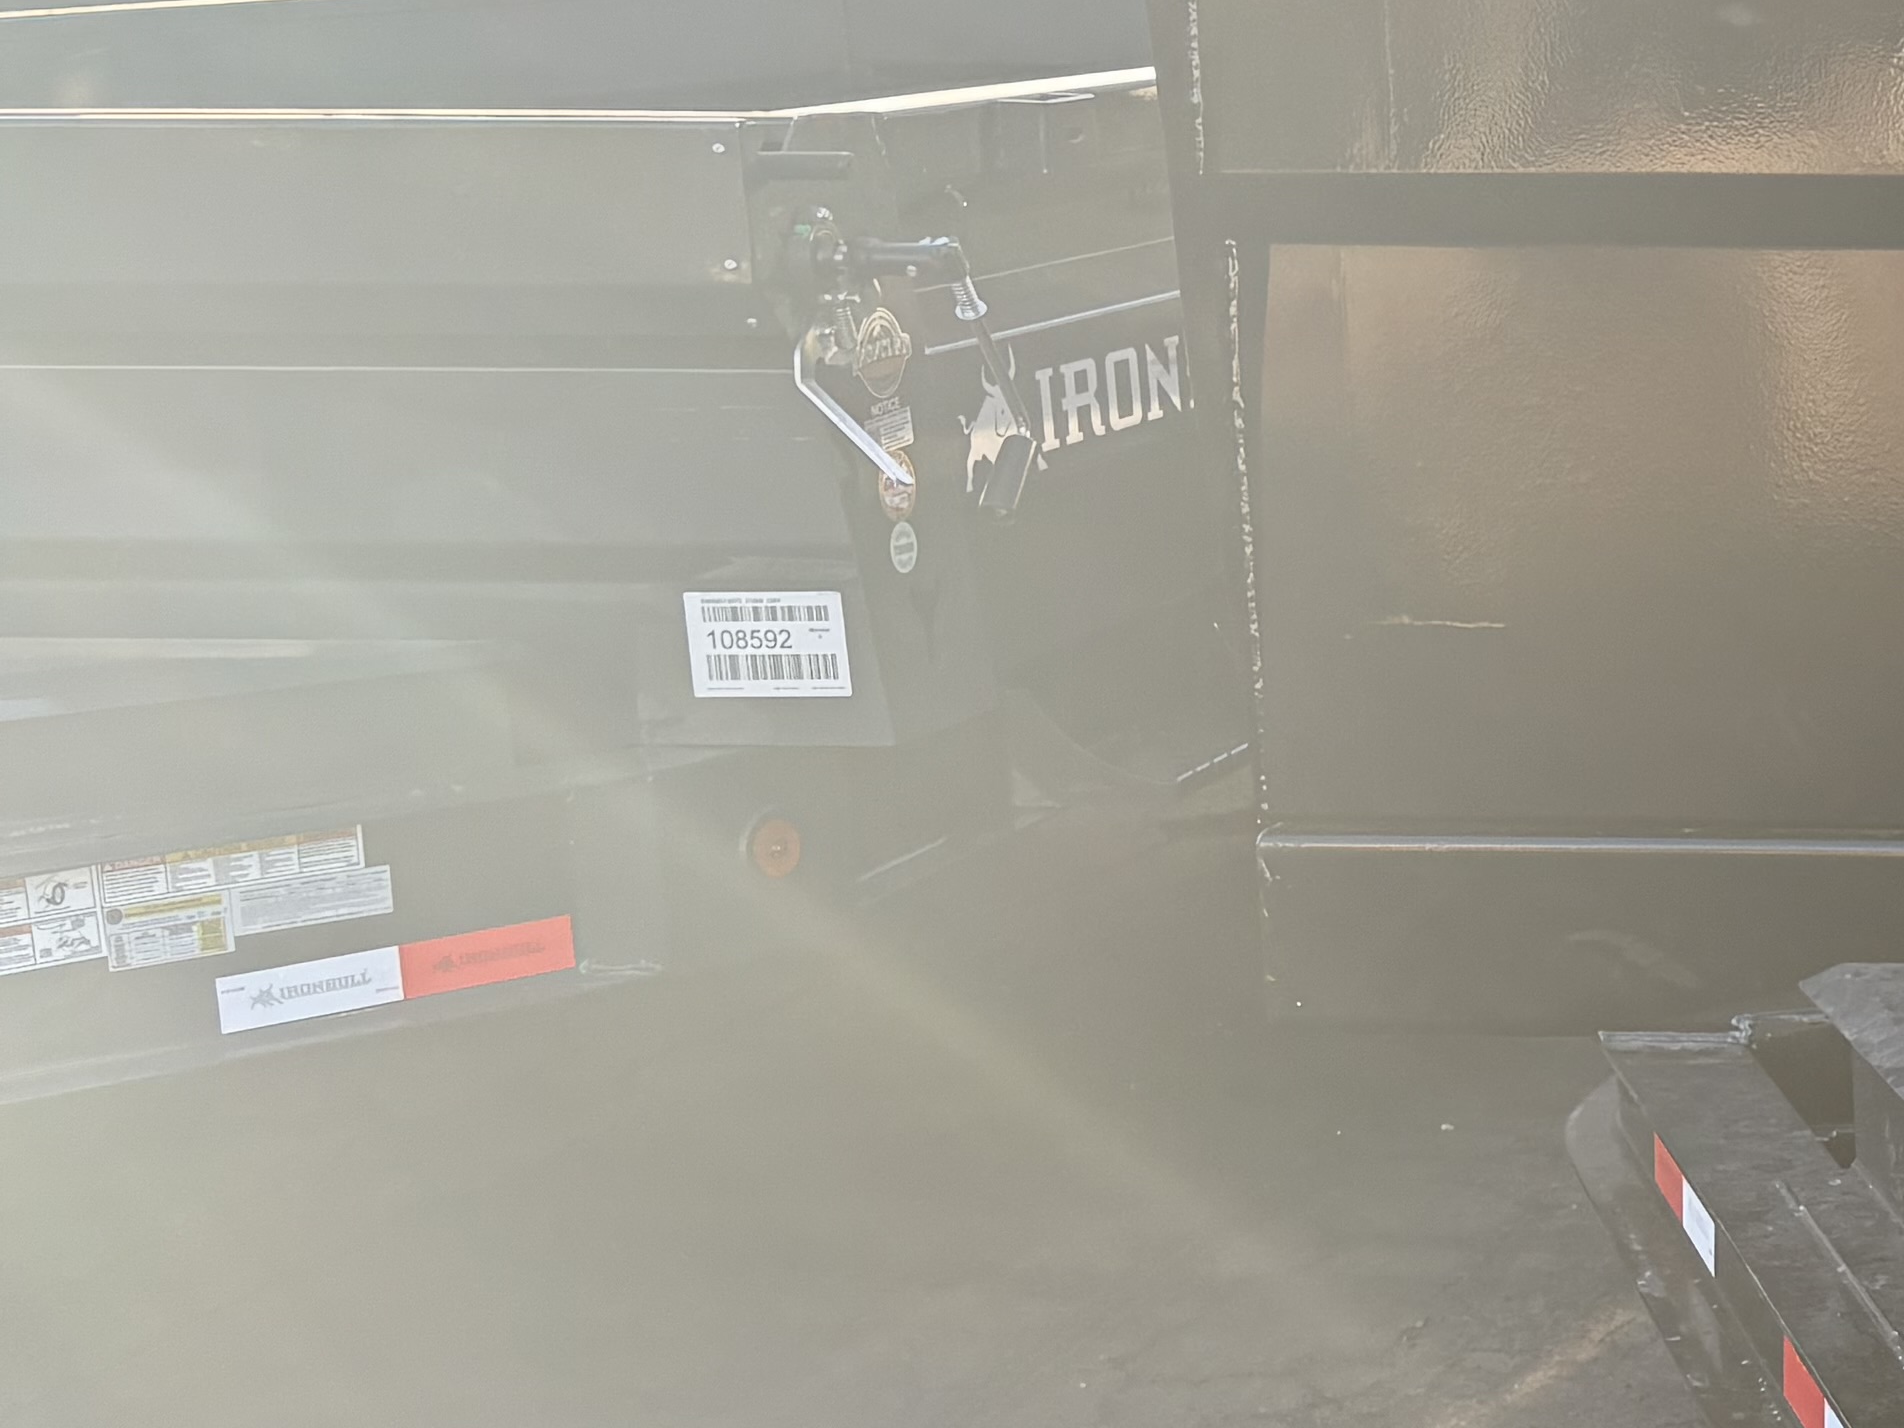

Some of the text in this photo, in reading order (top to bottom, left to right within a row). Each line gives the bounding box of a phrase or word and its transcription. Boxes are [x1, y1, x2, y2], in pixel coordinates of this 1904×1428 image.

[1035, 335, 1195, 452] IRON
[706, 629, 793, 650] 108592
[279, 969, 374, 1002] IRONBULL
